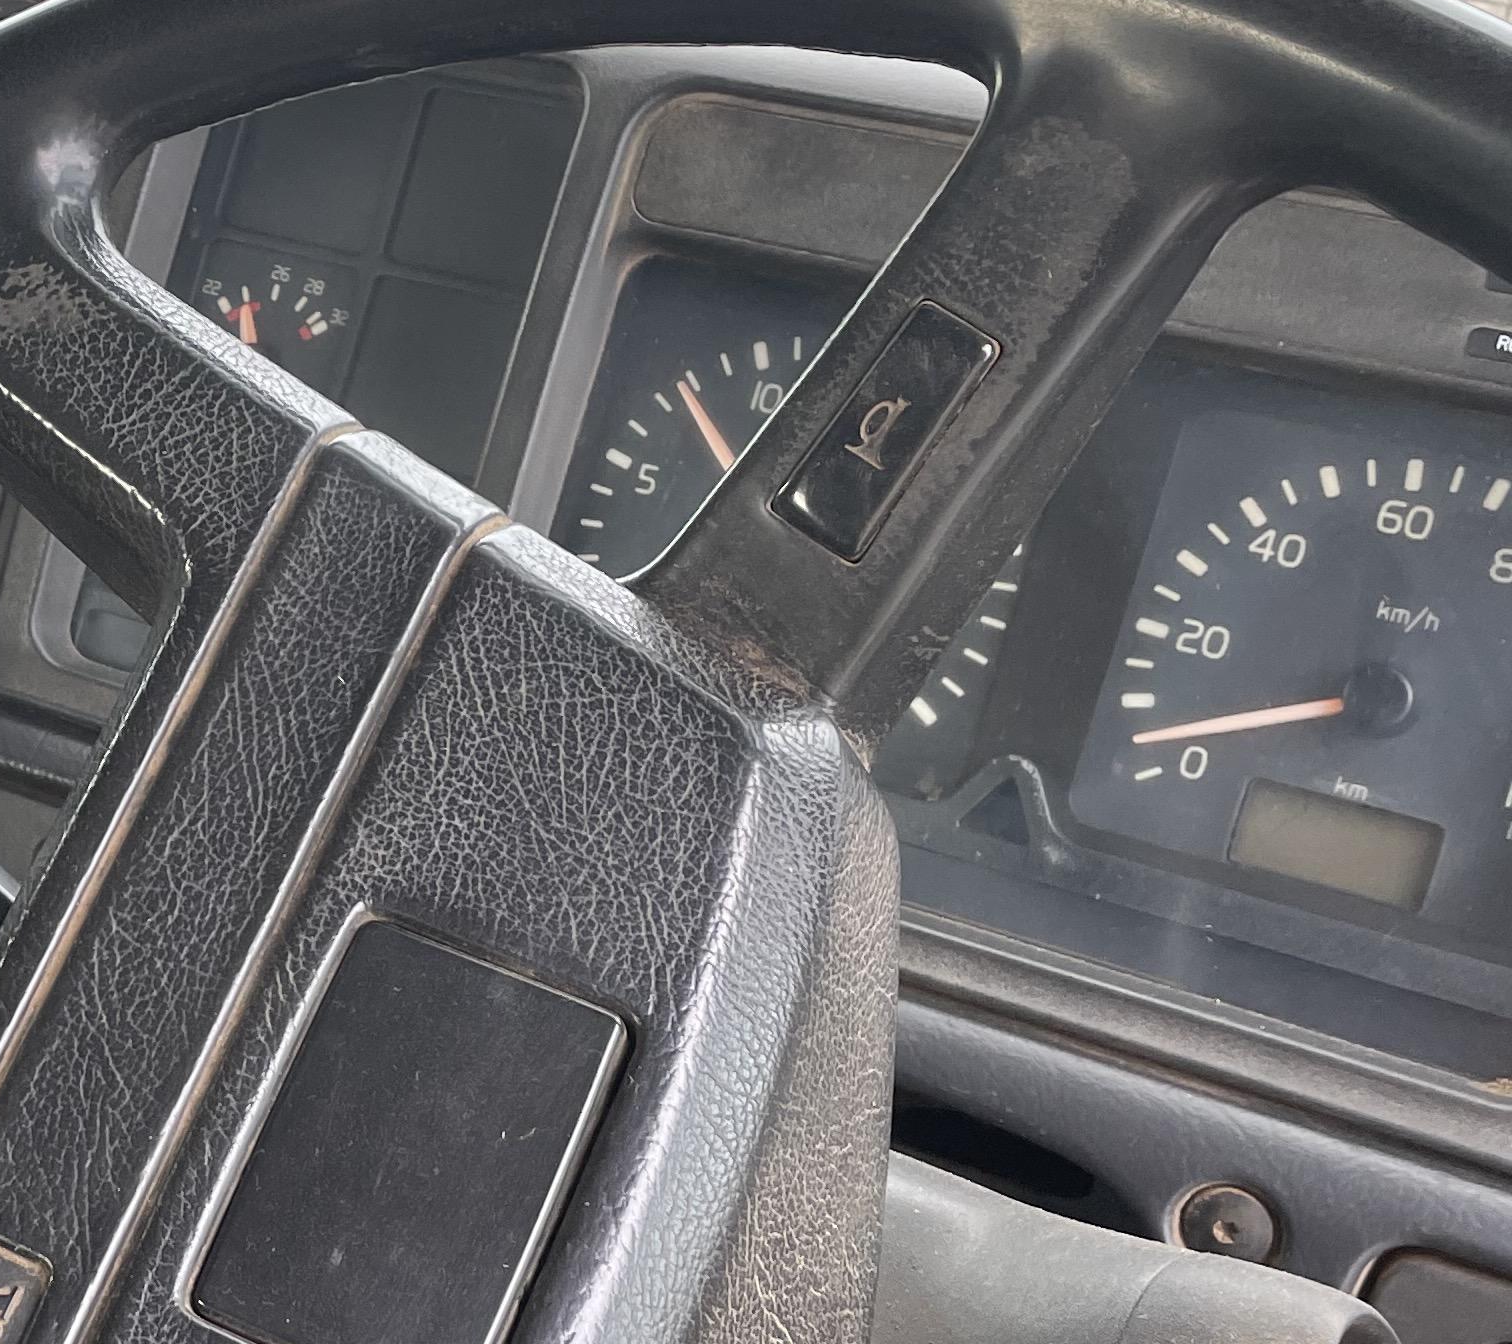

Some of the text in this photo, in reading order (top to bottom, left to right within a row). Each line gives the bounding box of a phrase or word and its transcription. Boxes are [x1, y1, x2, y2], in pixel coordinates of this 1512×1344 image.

[201, 278, 223, 297] 22
[271, 263, 292, 283] 26
[303, 276, 327, 296] 28
[329, 307, 350, 327] 32
[749, 380, 785, 414] 10
[634, 463, 660, 496] 5
[1376, 498, 1435, 541] 60
[1248, 526, 1307, 569] 40
[1375, 594, 1441, 634] km/h
[1175, 617, 1232, 661] 20
[1179, 744, 1209, 780] 0
[1332, 775, 1370, 802] km
